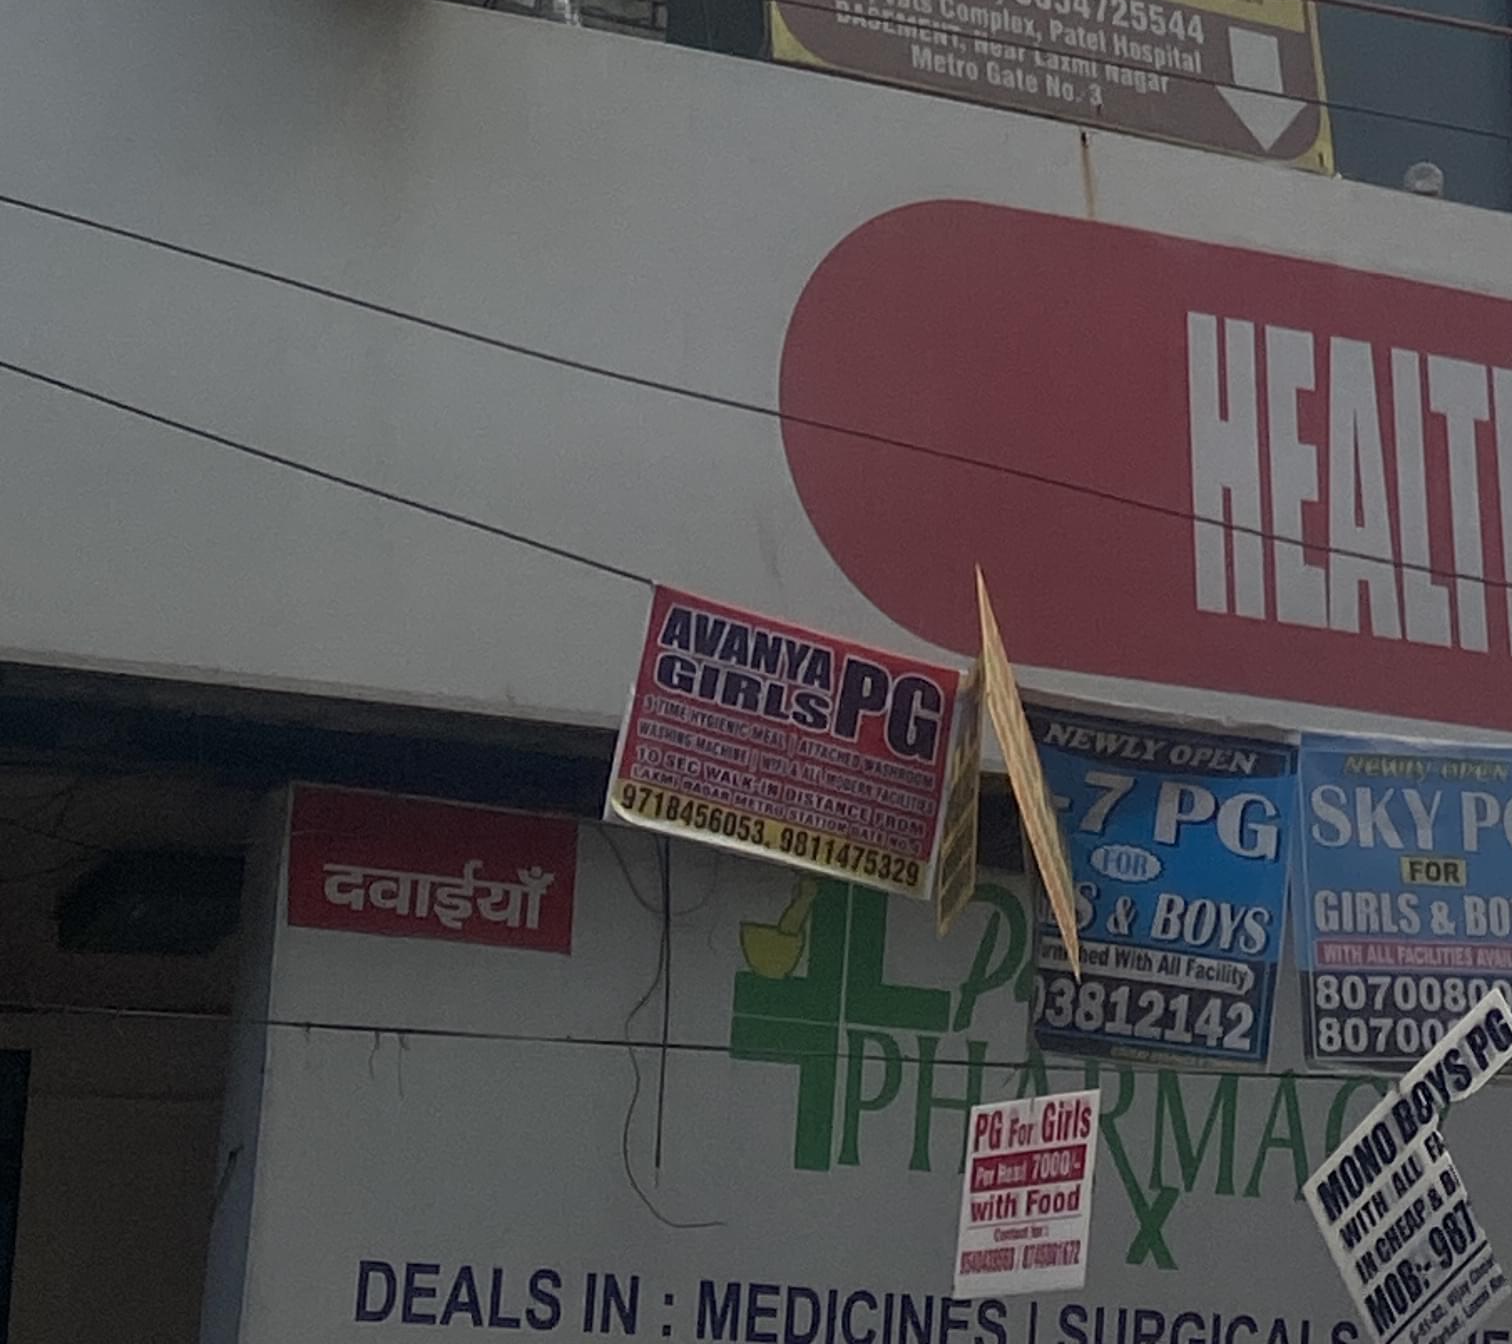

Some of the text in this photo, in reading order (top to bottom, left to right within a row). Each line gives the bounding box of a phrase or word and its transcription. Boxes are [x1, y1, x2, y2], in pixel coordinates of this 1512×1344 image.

[911, 45, 1038, 94] Metro Gate
[1049, 18, 1105, 54] Patel
[1113, 33, 1202, 75] Hospital
[655, 654, 831, 732] GIRLS
[658, 607, 944, 763] AVANYA PG
[1043, 722, 1259, 775] NEWLY OPEN
[1153, 780, 1282, 862] PG
[1310, 784, 1443, 851] SKY
[779, 826, 921, 889] 9811475329
[1102, 848, 1150, 876] FOR
[1408, 859, 1462, 884] FOR
[1105, 895, 1137, 937] &
[1150, 892, 1273, 955] BOYS
[1314, 889, 1421, 937] GIRLS
[1430, 900, 1457, 937] &
[1115, 947, 1250, 988] With All Facility
[1322, 943, 1364, 964] WITH
[1367, 944, 1396, 965] ALL
[1399, 945, 1474, 968] FACILITIES
[973, 1099, 1093, 1154] PG For Girls
[1315, 1121, 1398, 1223] MONO
[1391, 1047, 1474, 1145] BOYS
[970, 1183, 1082, 1223] with Food
[1338, 1155, 1425, 1250] WITH ALL
[1355, 1196, 1428, 1285] IN CHEAP
[353, 1257, 563, 1332] DEALS
[584, 1269, 640, 1335] IN
